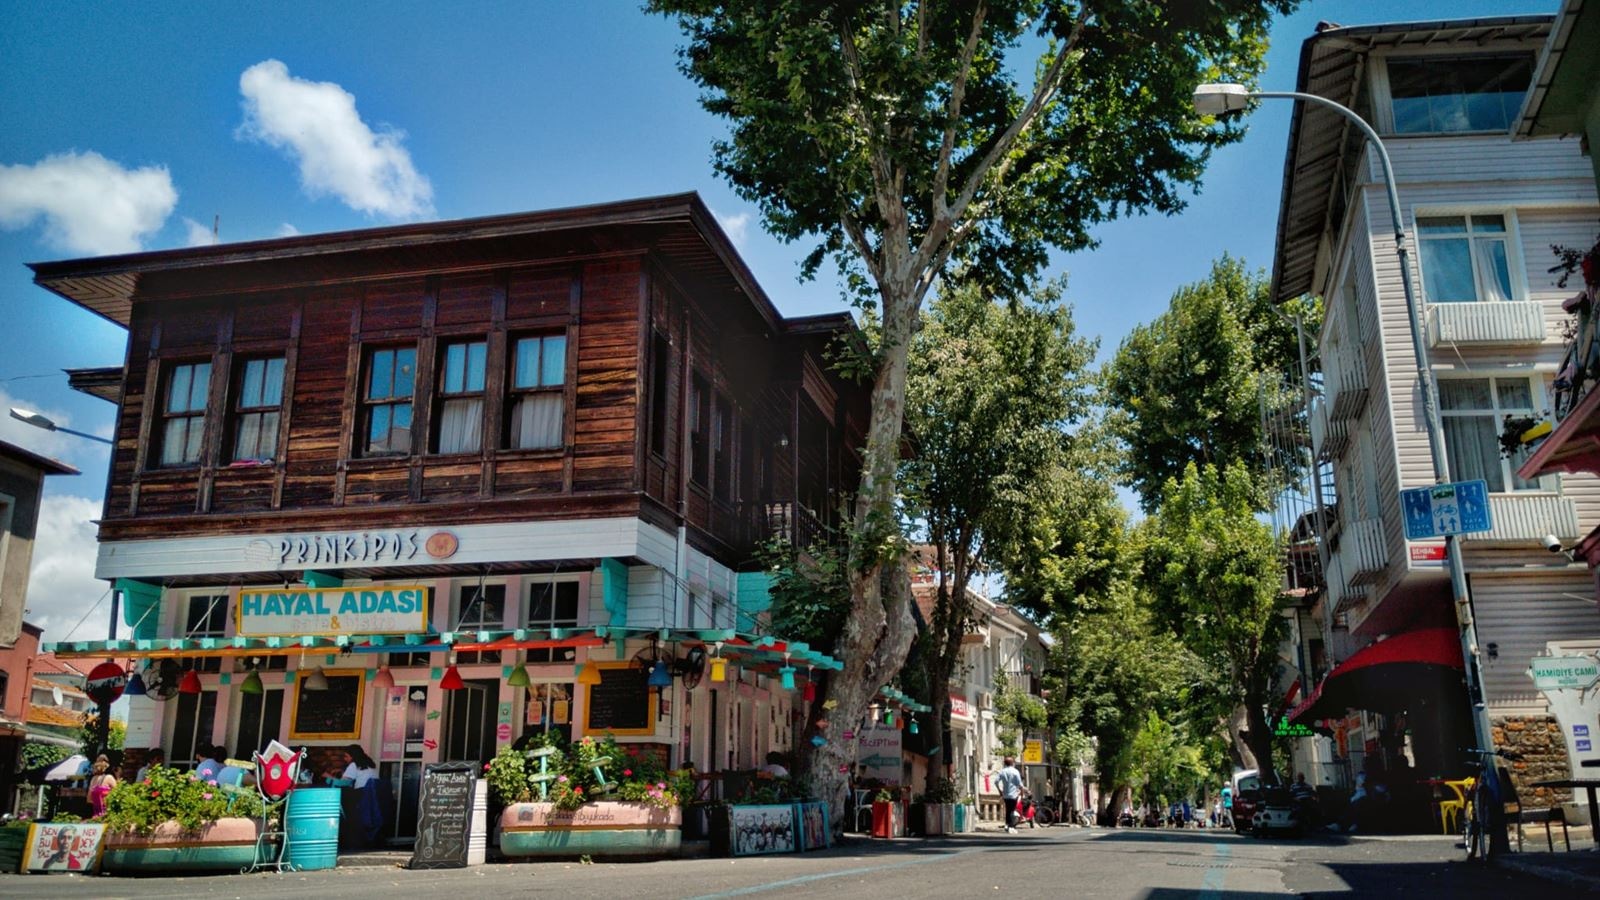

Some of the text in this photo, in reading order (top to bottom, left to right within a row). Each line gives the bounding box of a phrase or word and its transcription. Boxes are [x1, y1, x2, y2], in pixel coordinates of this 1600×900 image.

[242, 589, 423, 616] HAYAL ADASI
[330, 615, 341, 630] &
